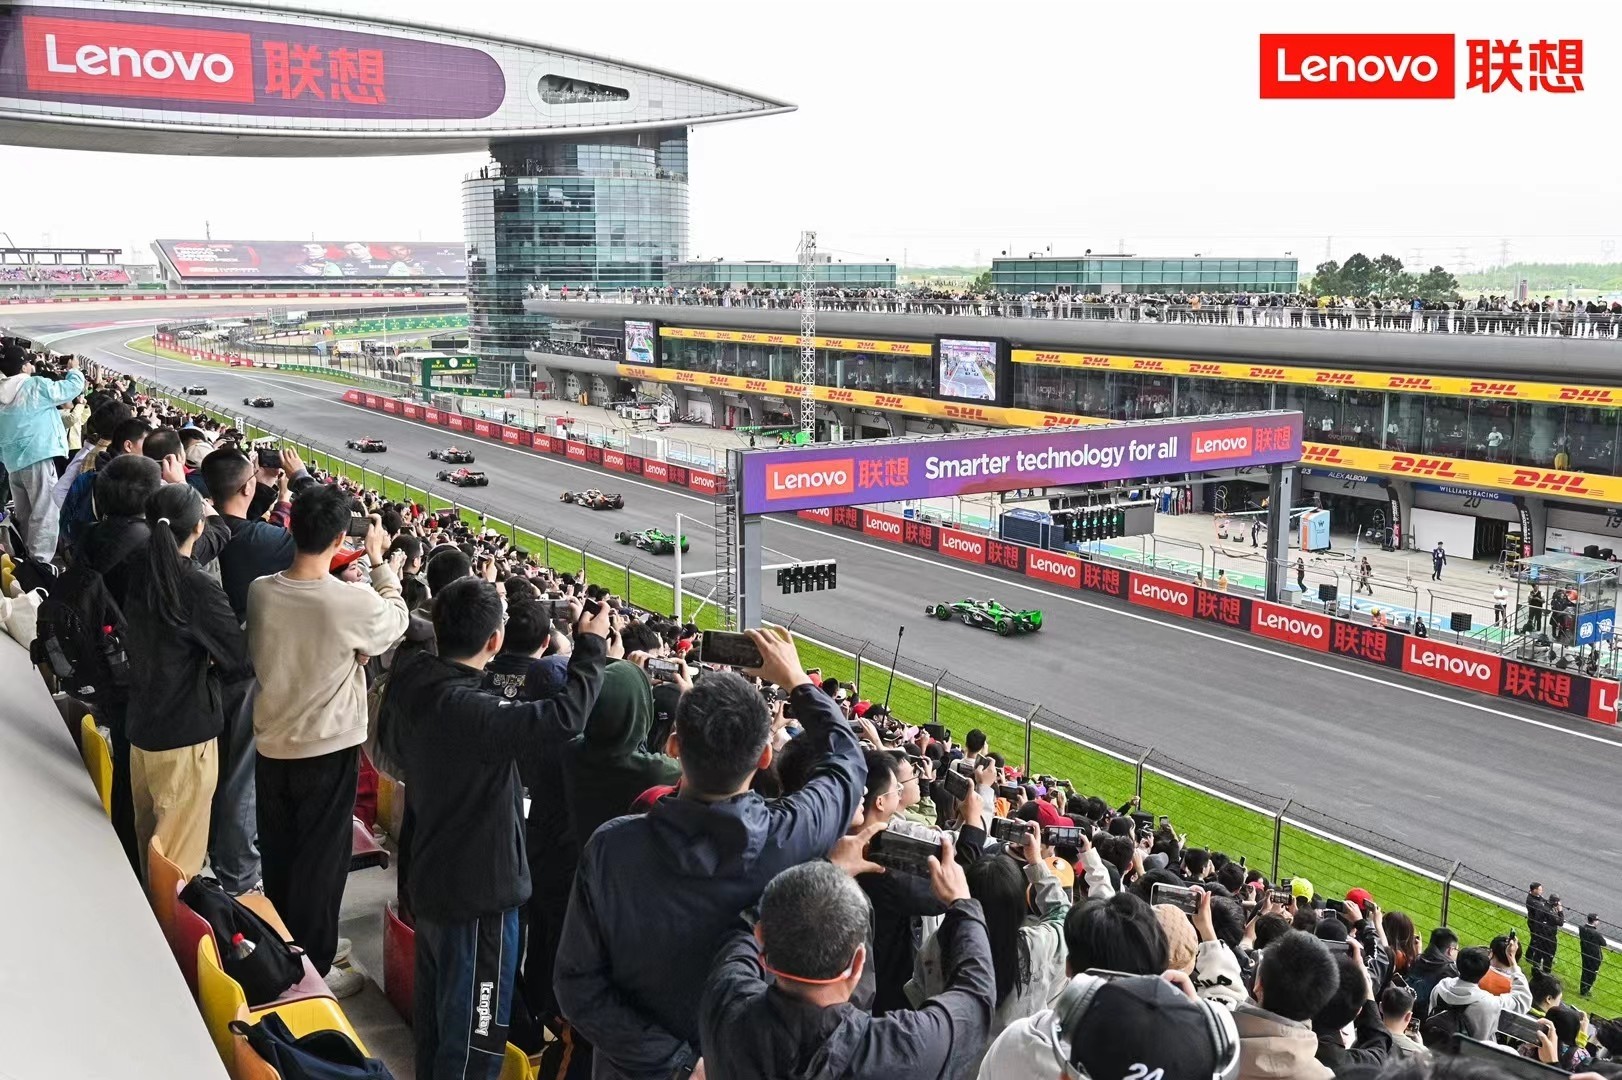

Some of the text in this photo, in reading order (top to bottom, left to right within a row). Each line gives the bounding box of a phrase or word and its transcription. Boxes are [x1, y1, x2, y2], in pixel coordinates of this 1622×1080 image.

[45, 33, 234, 83] Lenovo
[262, 40, 387, 105] 联想
[768, 335, 783, 343] DHL
[825, 339, 843, 347] DHL
[857, 342, 876, 350] DHL
[891, 344, 910, 352] DHL
[1035, 353, 1061, 363] DHL
[1082, 356, 1110, 367] DHL
[1133, 360, 1164, 371] DHL
[1189, 363, 1222, 375] DHL
[1250, 367, 1285, 379] DHL
[676, 372, 694, 382] DHL
[709, 375, 729, 387] DHL
[1315, 372, 1355, 384] DHL
[1389, 377, 1432, 390] DHL
[745, 380, 768, 392] DHL
[1470, 382, 1518, 396] DHL
[827, 389, 854, 402] DHL
[875, 395, 903, 408] DHL
[1559, 388, 1613, 402] DHL
[944, 405, 989, 421] DHL
[475, 423, 489, 433] Lenovo
[503, 430, 518, 440] Lenovo
[534, 436, 550, 448] Lenovo
[1196, 435, 1248, 454] Lenovo
[1255, 425, 1292, 452] 联想
[567, 443, 585, 456] Lenovo
[604, 452, 623, 466] Lenovo
[925, 436, 1178, 480] Smarter technology for all
[645, 461, 666, 477] Lenovo
[858, 457, 910, 489] 联想
[1391, 456, 1457, 478] DHL
[691, 473, 715, 488] Lenovo
[773, 470, 847, 490] Lenovo
[1328, 471, 1368, 483] ALEX ALBON
[1511, 469, 1590, 495] DHL
[1464, 496, 1482, 508] 20
[834, 506, 857, 529] 联想
[866, 516, 900, 534] Lenovo
[905, 520, 932, 547] 联想
[943, 533, 981, 555] Lenovo
[988, 541, 1019, 569] 联想
[1031, 554, 1076, 578] Lenovo
[1084, 564, 1120, 595] 联想
[1134, 578, 1188, 606] Lenovo
[1197, 591, 1241, 625] 联想
[1258, 608, 1323, 639] Lenovo
[1334, 622, 1387, 663] 联想
[1410, 644, 1491, 681] Lenovo
[1504, 662, 1572, 709] 联想
[475, 981, 494, 1037] Icanplay
